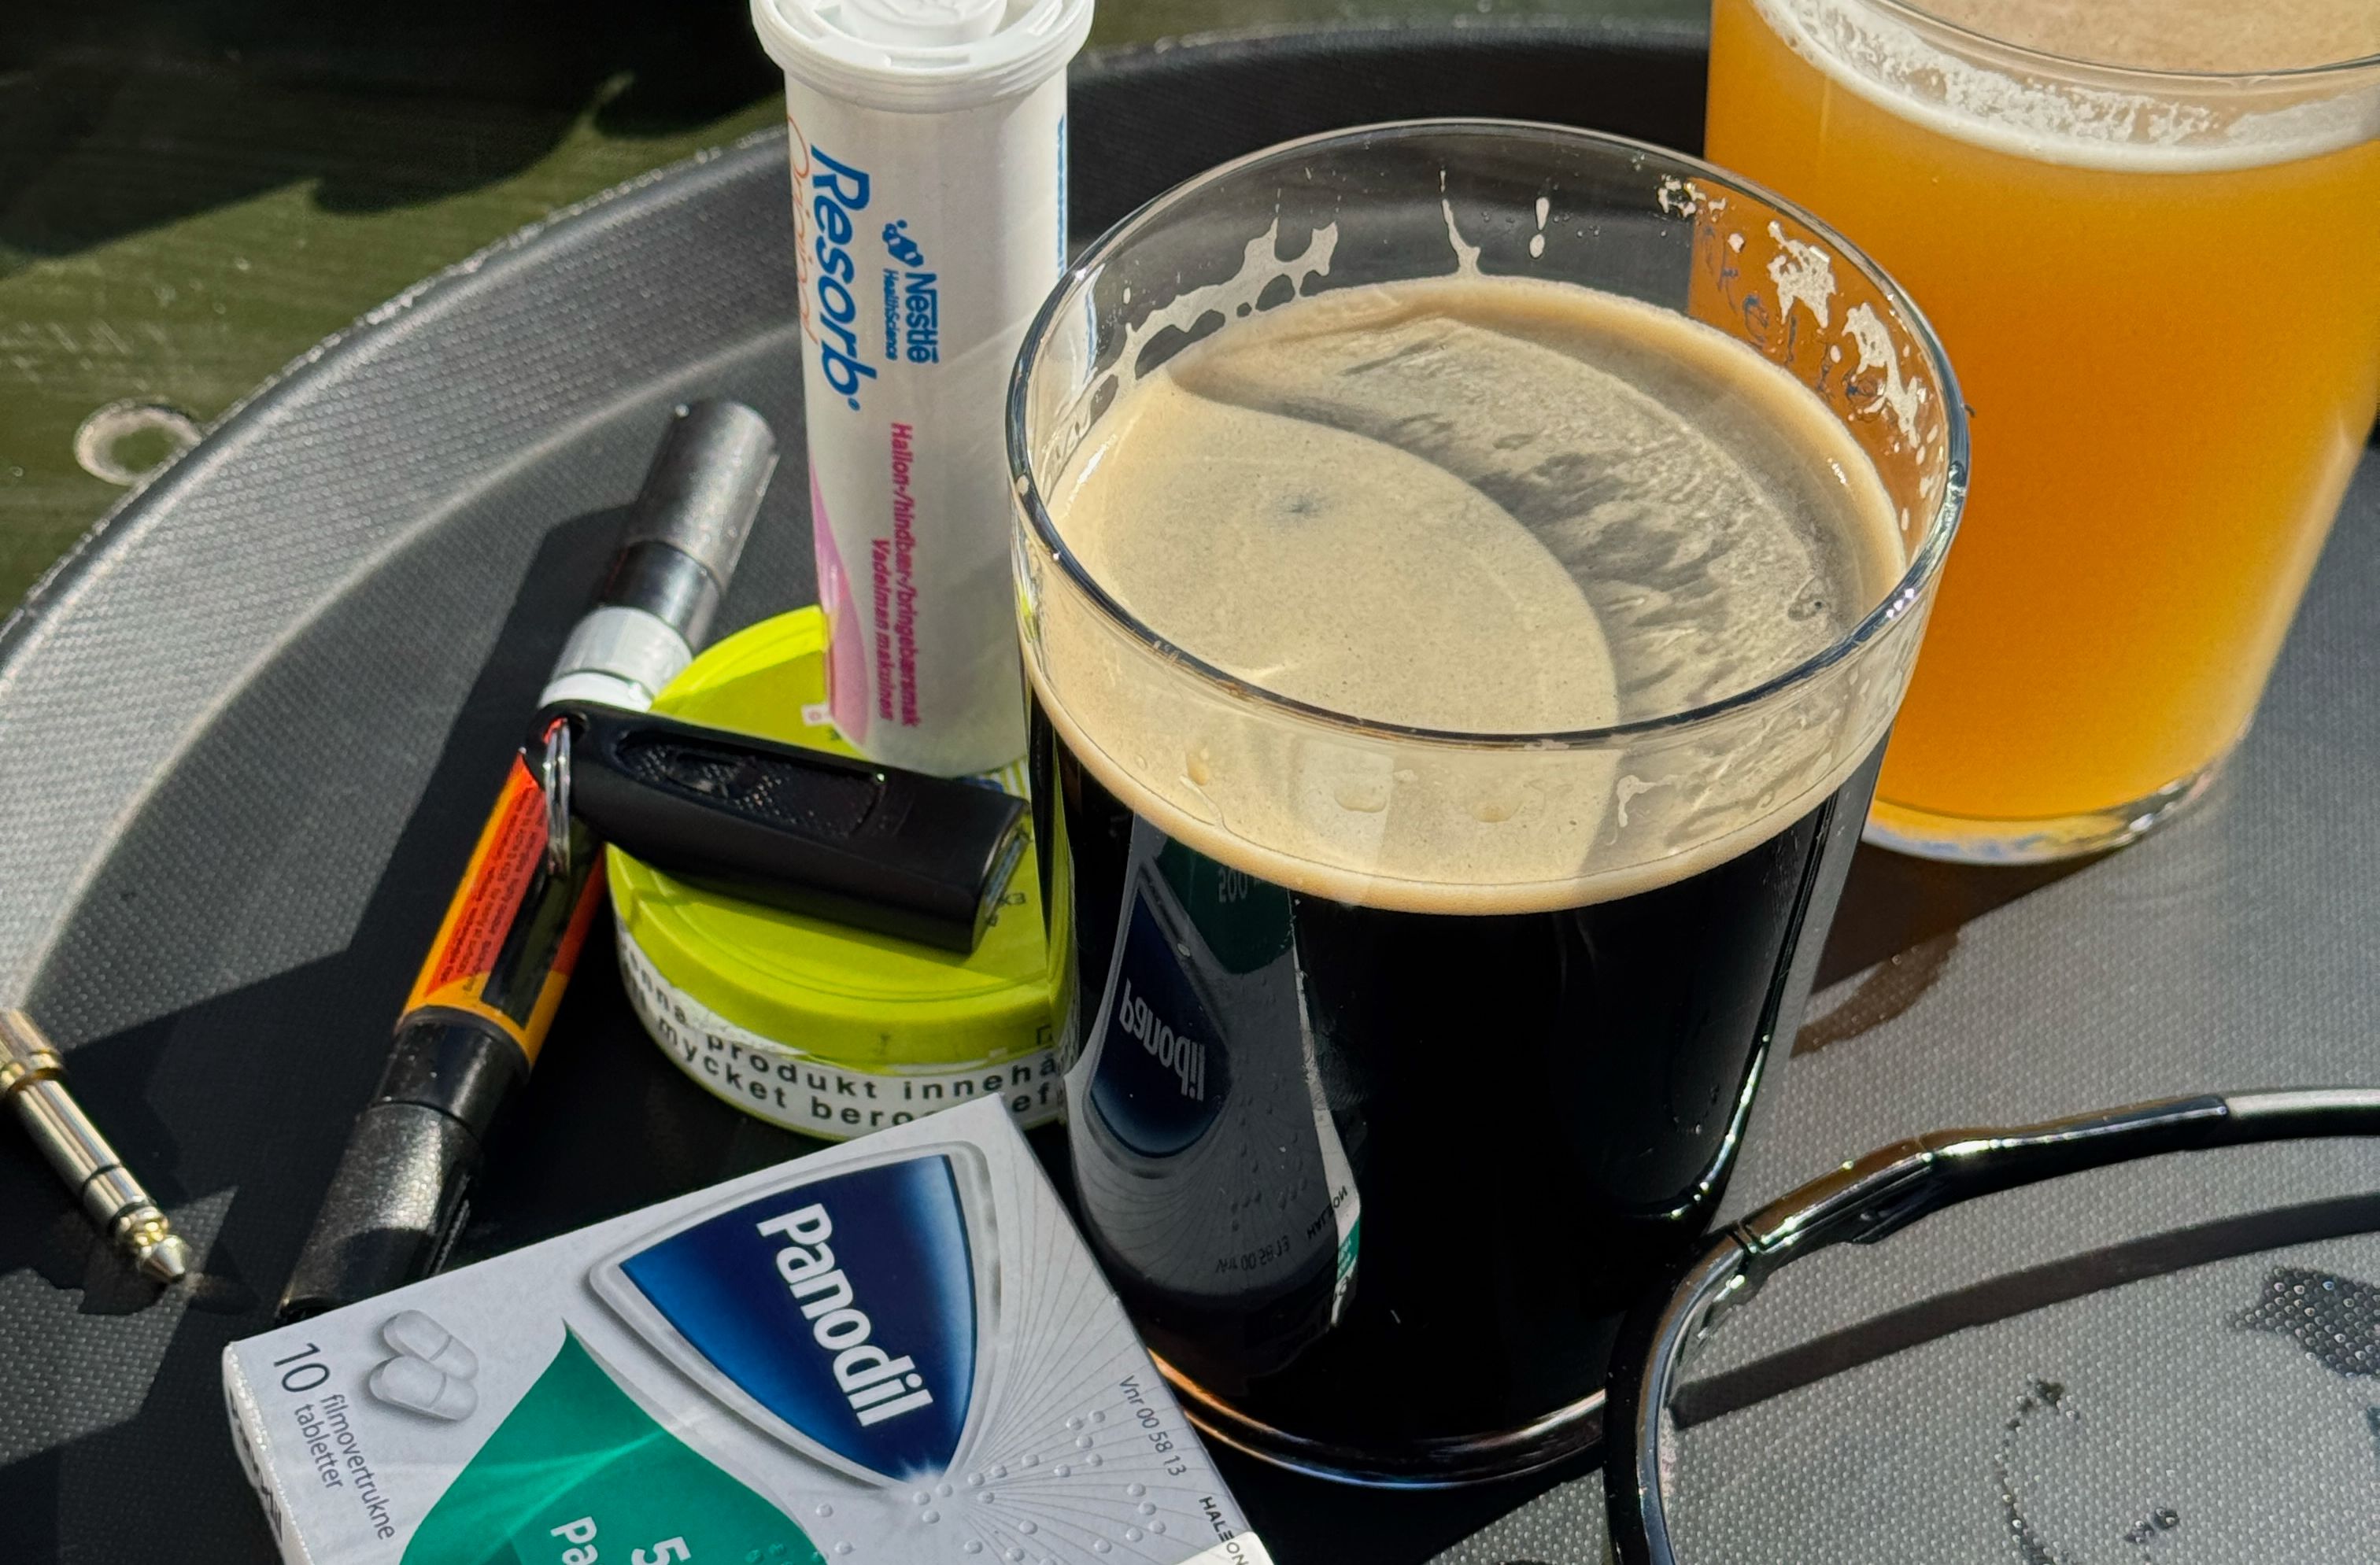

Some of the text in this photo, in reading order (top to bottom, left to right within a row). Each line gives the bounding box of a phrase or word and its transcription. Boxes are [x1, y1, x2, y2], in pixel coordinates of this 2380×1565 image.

[810, 144, 878, 396] Resorb
[905, 271, 940, 364] Nestlé
[658, 1017, 789, 1109] mycket
[706, 1033, 878, 1100] produkt
[756, 1202, 933, 1428] Panodil
[272, 1342, 331, 1393] 10
[294, 1403, 345, 1489] tabletter
[319, 1393, 395, 1541] filmovertrukne
[1119, 1375, 1188, 1477] Vnr 00 58 13
